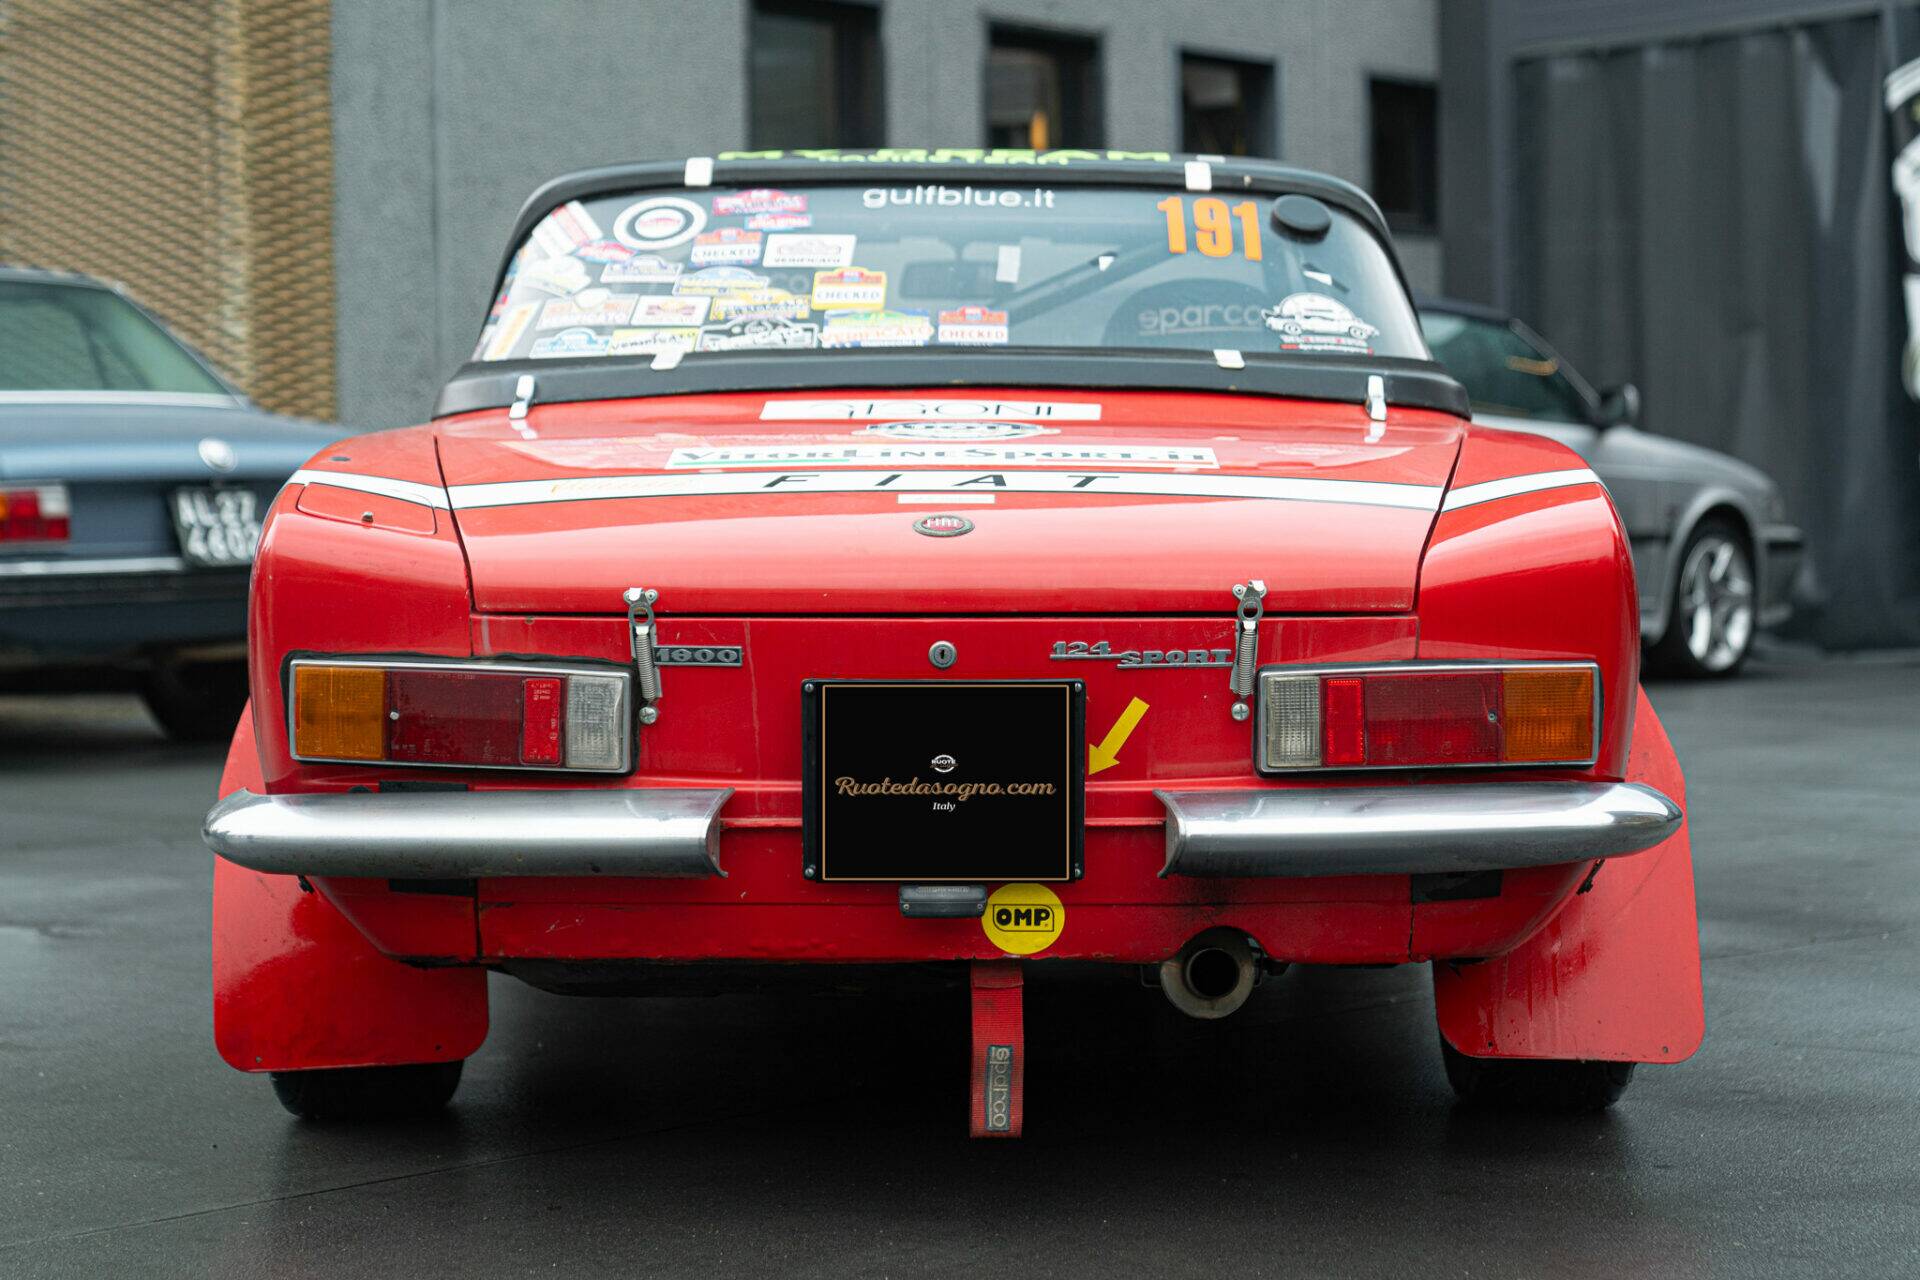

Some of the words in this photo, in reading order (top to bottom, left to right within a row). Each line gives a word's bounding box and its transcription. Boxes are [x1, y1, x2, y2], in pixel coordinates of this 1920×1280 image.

[863, 185, 1055, 209] gulfblue.it
[1157, 196, 1262, 262] 191
[816, 288, 881, 300] CHECKED
[1138, 304, 1262, 336] sparco
[940, 328, 1005, 340] CHECKED
[762, 473, 1120, 489] FIAT
[656, 648, 738, 662] 1600
[1053, 641, 1111, 656] 124
[1120, 648, 1232, 666] SPORT
[834, 776, 1056, 801] Ruotedasogno.com
[932, 801, 956, 813] Italy
[996, 908, 1050, 927] OMP
[989, 1046, 1010, 1129] sparco
